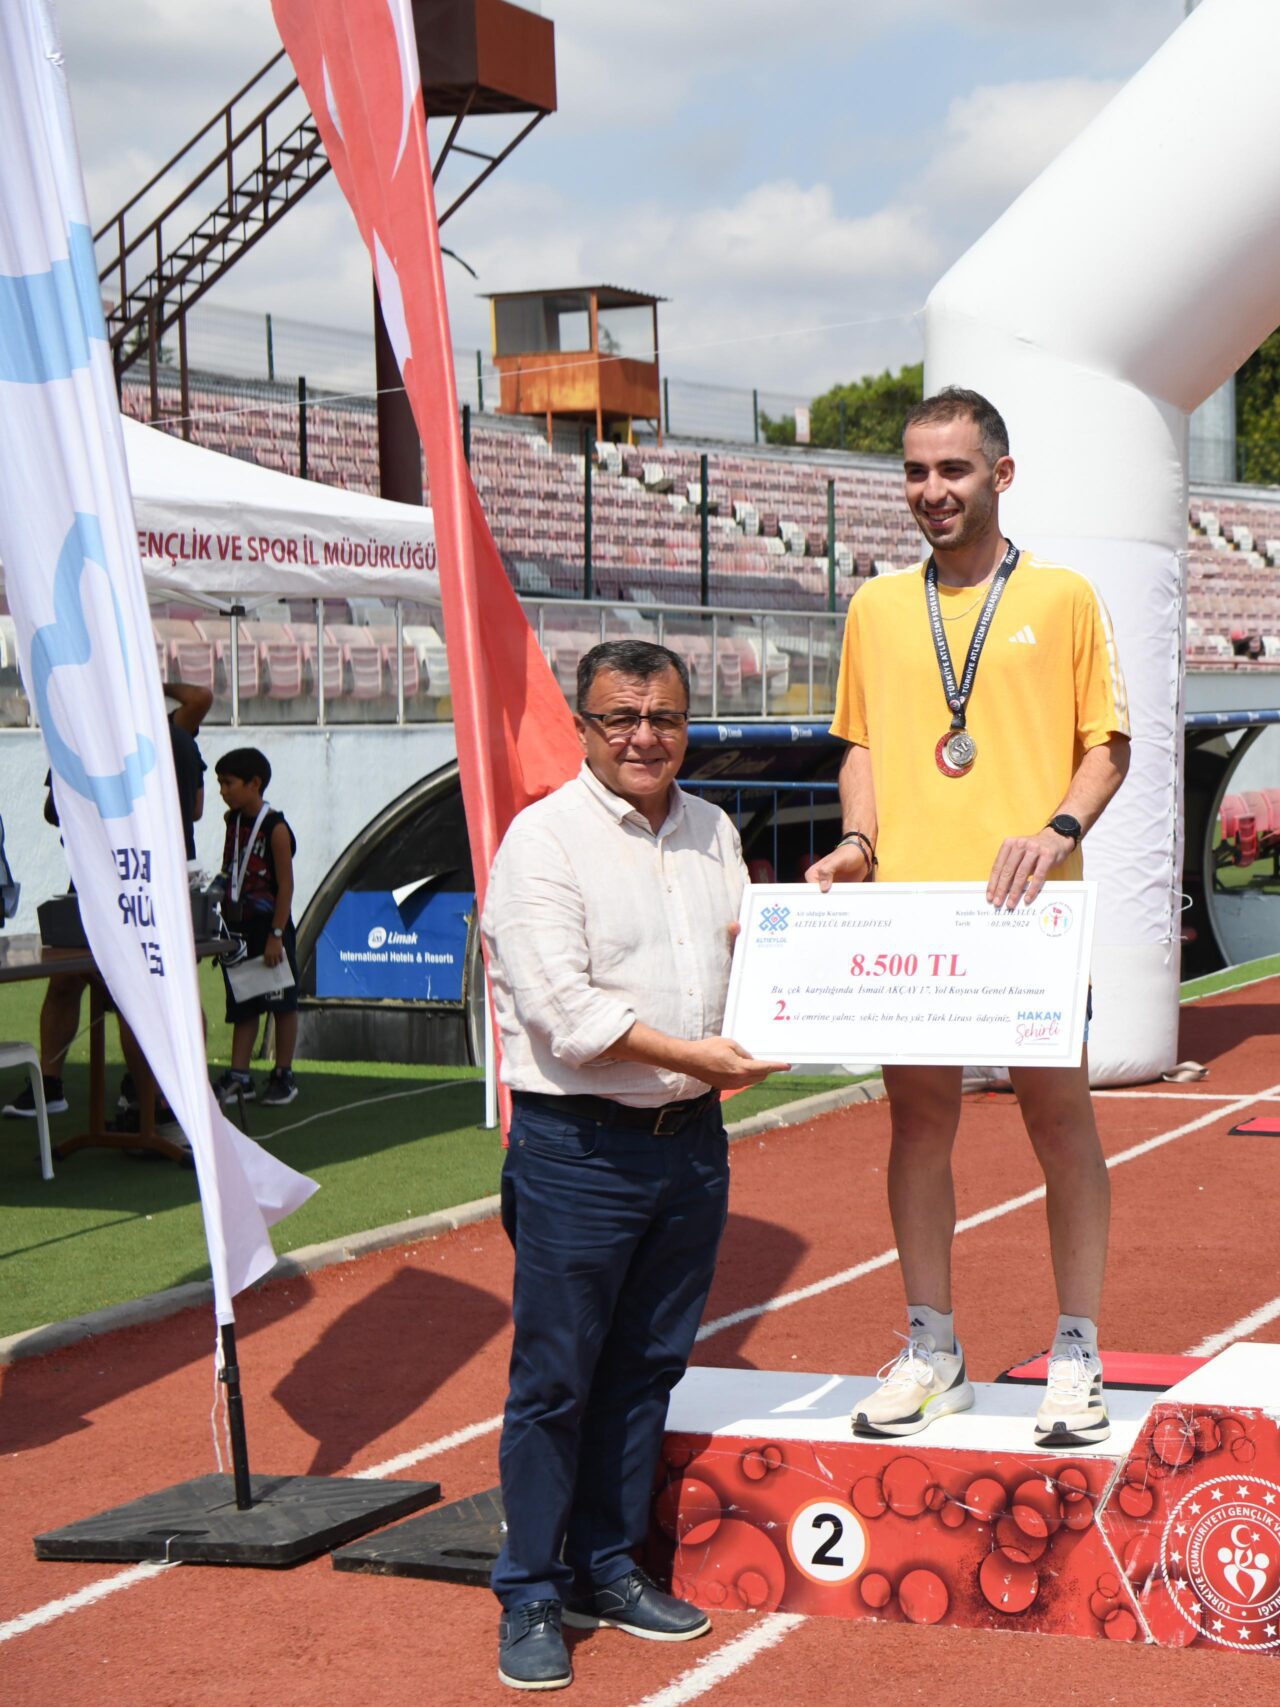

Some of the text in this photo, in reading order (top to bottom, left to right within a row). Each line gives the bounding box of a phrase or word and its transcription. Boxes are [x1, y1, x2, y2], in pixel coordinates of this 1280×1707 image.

[137, 528, 437, 570] ENÇLİK VE SPOR İL MÜDÜRLÜĞÜ
[981, 577, 1005, 625] FEDERASYONU
[388, 931, 418, 945] Limak
[340, 950, 388, 963] International
[390, 951, 414, 964] Hotels
[425, 952, 454, 965] Resorts
[850, 953, 967, 977] 8.500 TL
[981, 986, 1007, 995] Genel
[1008, 986, 1046, 995] Klasman
[773, 999, 791, 1021] 2.
[1016, 1010, 1062, 1021] HAKAN
[1228, 1507, 1274, 1527] GENÇLİK
[811, 1513, 844, 1567] 2
[1192, 1509, 1227, 1576] CUMHURİYETİ
[1195, 1576, 1231, 1615] TÜRKİYE
